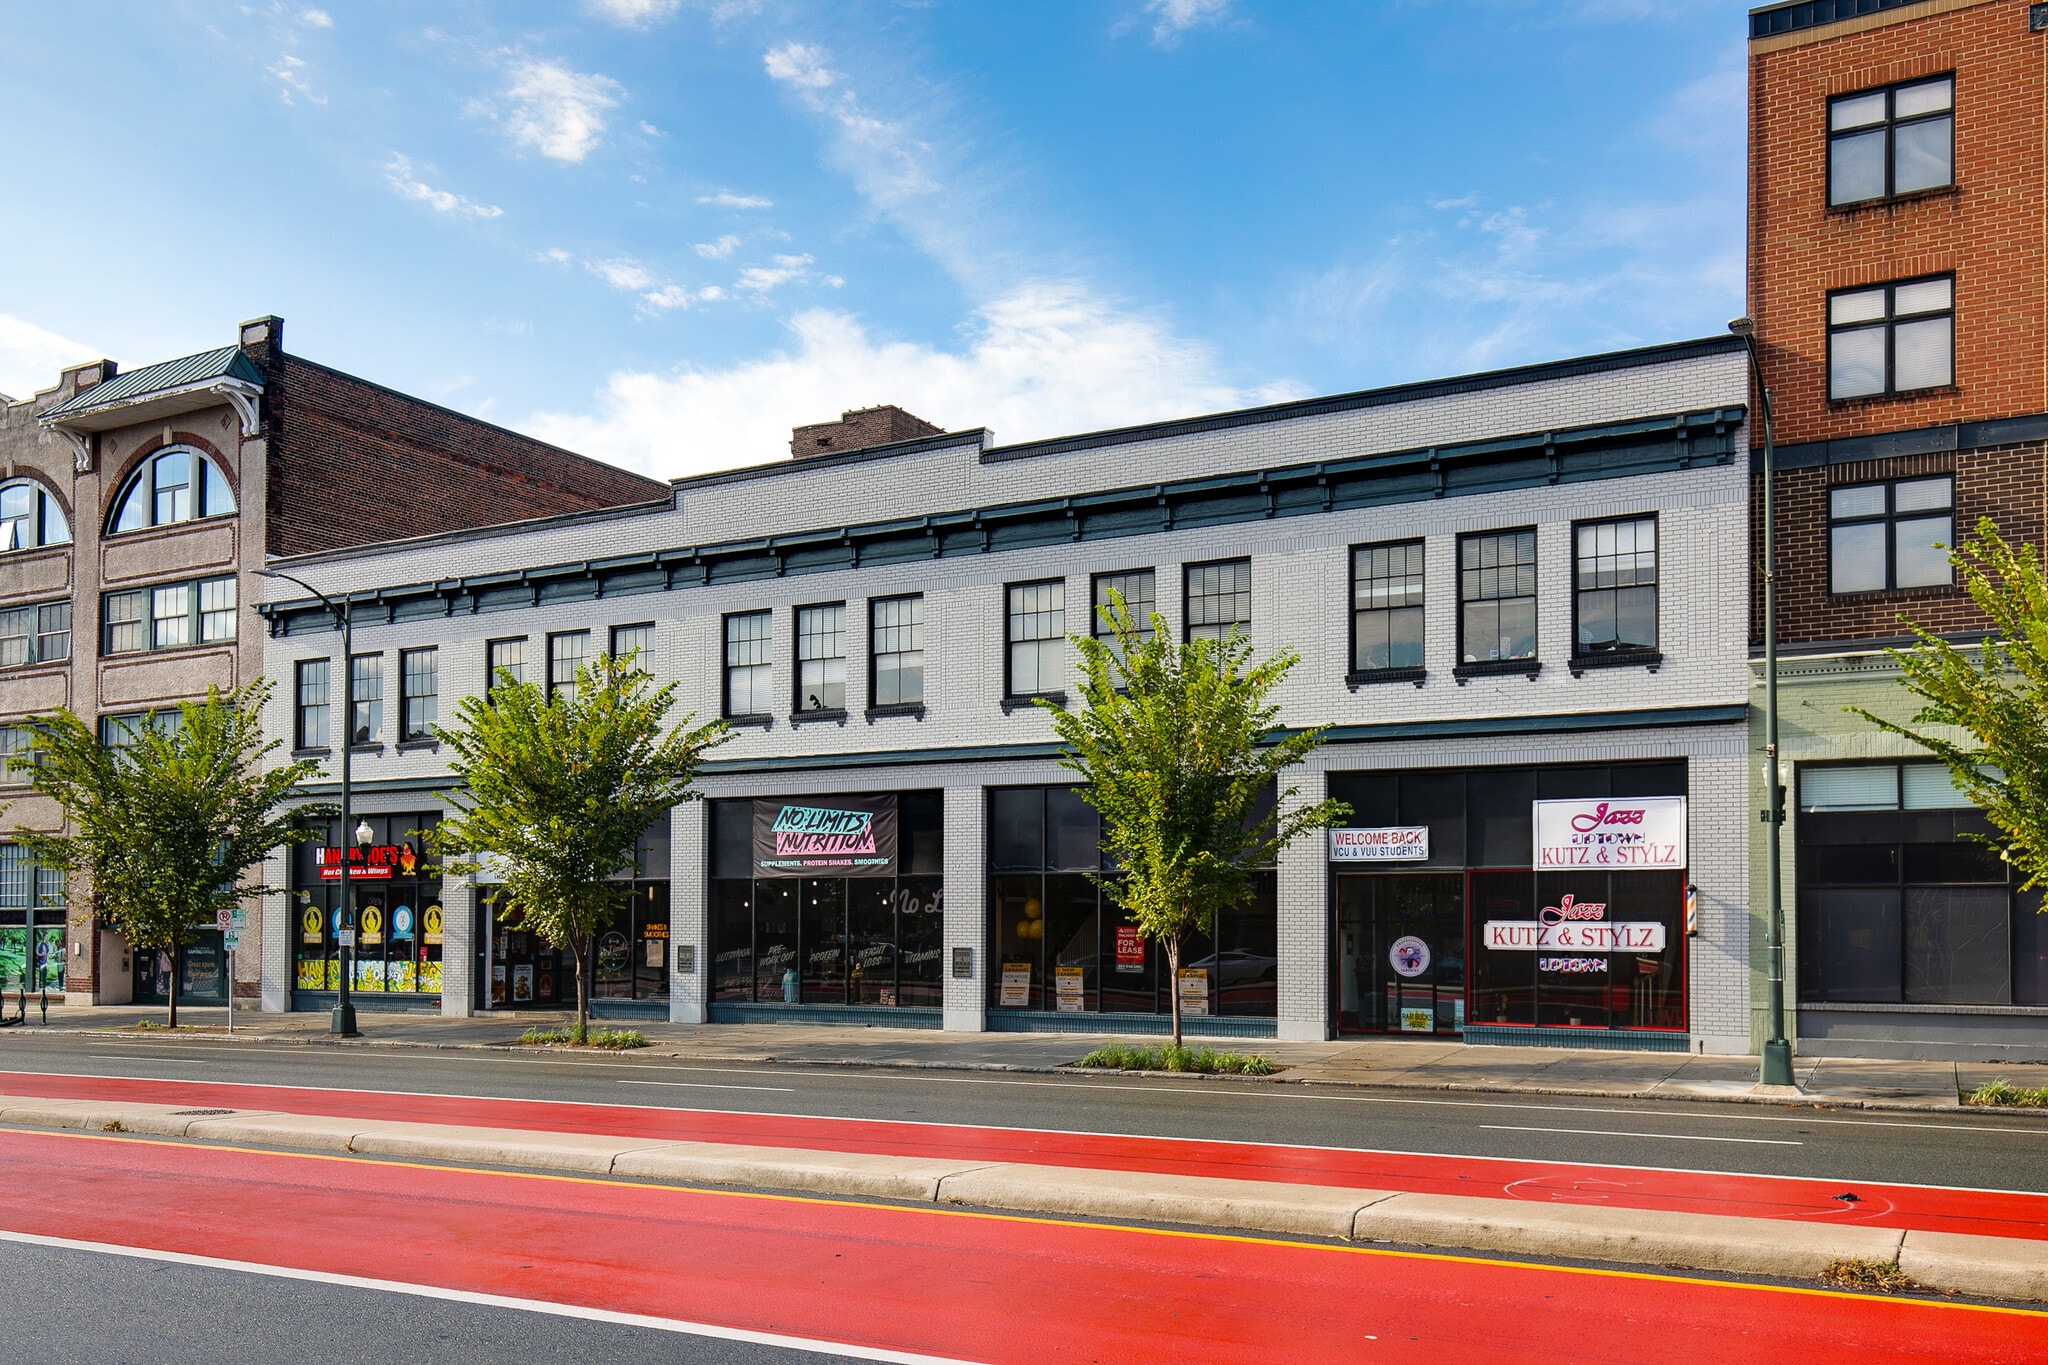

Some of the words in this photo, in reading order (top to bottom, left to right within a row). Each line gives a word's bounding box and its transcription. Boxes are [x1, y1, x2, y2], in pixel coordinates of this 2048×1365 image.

[776, 807, 804, 828] NO
[805, 811, 869, 833] LIMITS
[1571, 802, 1646, 833] Jazz
[779, 830, 874, 852] NUTRITION
[1335, 832, 1388, 846] WELCOME
[1391, 831, 1421, 844] BACK
[1572, 833, 1645, 845] UPTOWN
[315, 847, 362, 865] HANRY
[1333, 847, 1349, 857] VCU
[1352, 847, 1358, 857] &
[1361, 847, 1377, 856] VUU
[1380, 845, 1424, 856] STUDENTS
[1541, 846, 1590, 865] KUTZ
[1596, 846, 1610, 864] &
[1616, 842, 1676, 864] STYLZ
[803, 859, 828, 867] PROTEIN
[854, 858, 889, 866] SMOOTHIES
[367, 867, 389, 876] Wings
[1539, 894, 1607, 927] Jazz
[1117, 939, 1134, 947] FOR
[1492, 926, 1550, 946] KUTZ
[1557, 926, 1575, 946] &
[1580, 925, 1655, 947] STYLZ
[809, 949, 841, 962] PROTEIN
[858, 945, 887, 959] WEIGHT
[905, 949, 941, 964] VITAMINS
[1117, 946, 1143, 954] LEASE
[863, 956, 883, 967] LOSS
[1538, 956, 1608, 973] UPTOWN
[1415, 1013, 1433, 1021] BUCKS
